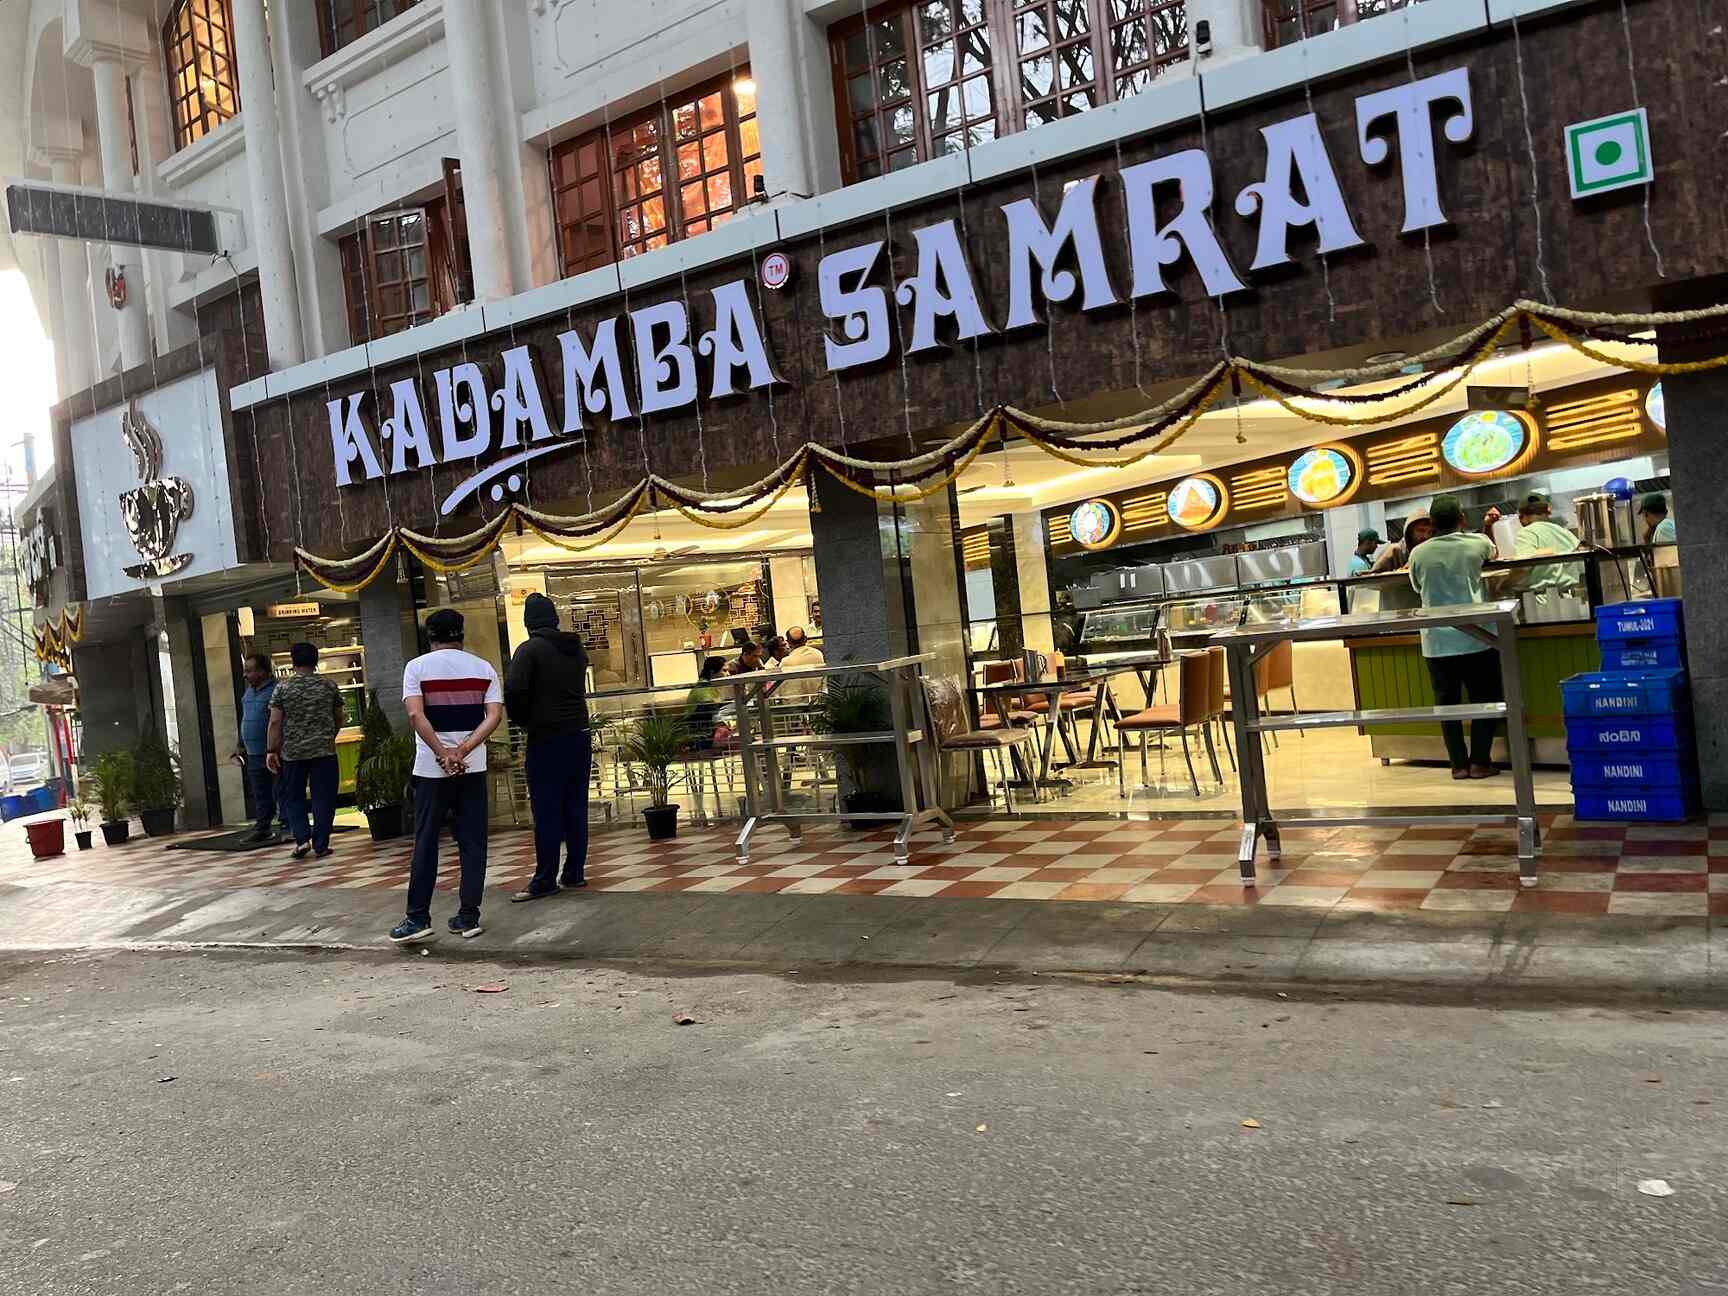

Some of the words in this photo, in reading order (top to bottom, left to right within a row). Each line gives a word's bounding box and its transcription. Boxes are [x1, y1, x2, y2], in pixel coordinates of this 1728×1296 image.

[326, 279, 777, 487] KADAMBA
[817, 66, 1472, 371] SAMRAT
[768, 264, 784, 277] TM
[1595, 695, 1638, 708] NANDINI
[1599, 729, 1641, 743] ನಂದಿನಿ
[1604, 765, 1643, 779] NANDINI
[1608, 799, 1647, 813] NANDINI
